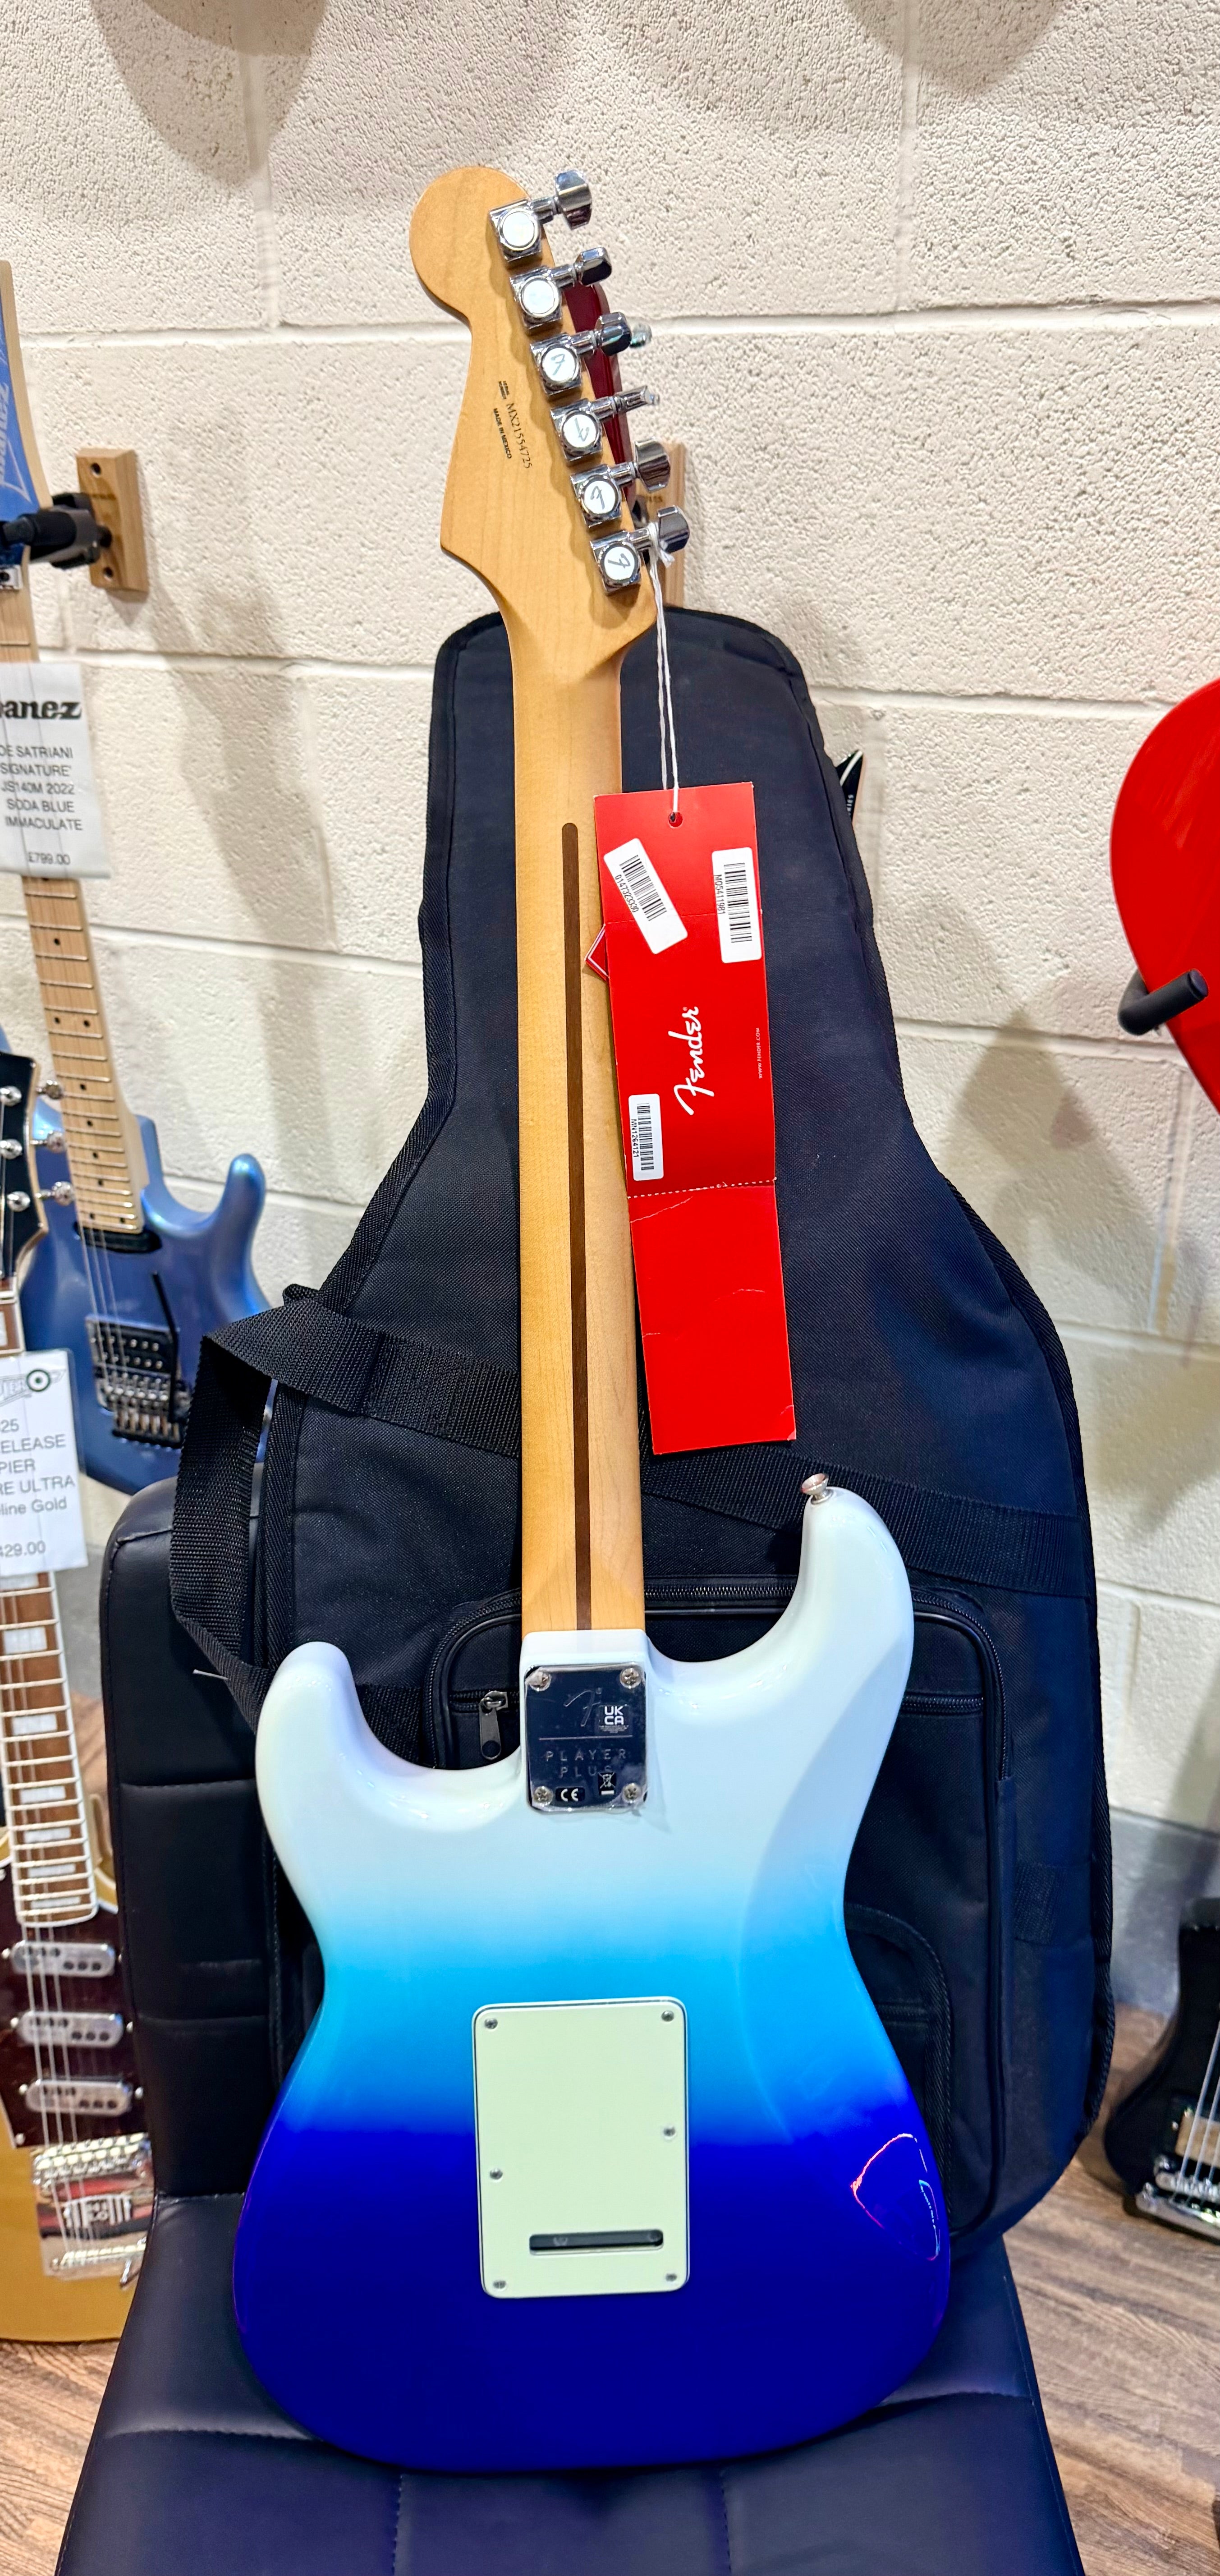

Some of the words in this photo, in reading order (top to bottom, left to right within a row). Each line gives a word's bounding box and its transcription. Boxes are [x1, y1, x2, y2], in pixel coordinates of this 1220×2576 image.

[493, 408, 502, 426] MADE
[501, 434, 512, 459] MEXICO
[506, 403, 532, 469] MX21554725
[16, 745, 73, 758] SATRIANI
[46, 782, 75, 795] 2022
[7, 799, 39, 810] SODA
[42, 800, 74, 812] BLUE
[5, 816, 83, 830] IMMACULATE
[668, 1007, 715, 1116] Fender
[0, 1418, 19, 1433] 25
[0, 1434, 66, 1454] ELEASE
[20, 1475, 75, 1493] ULTRA
[0, 1503, 26, 1515] line
[32, 1496, 67, 1513] Gold
[605, 1706, 624, 1715] UK
[605, 1716, 624, 1725] CA
[546, 1749, 626, 1762] PLAYER
[560, 1789, 578, 1802] CE
